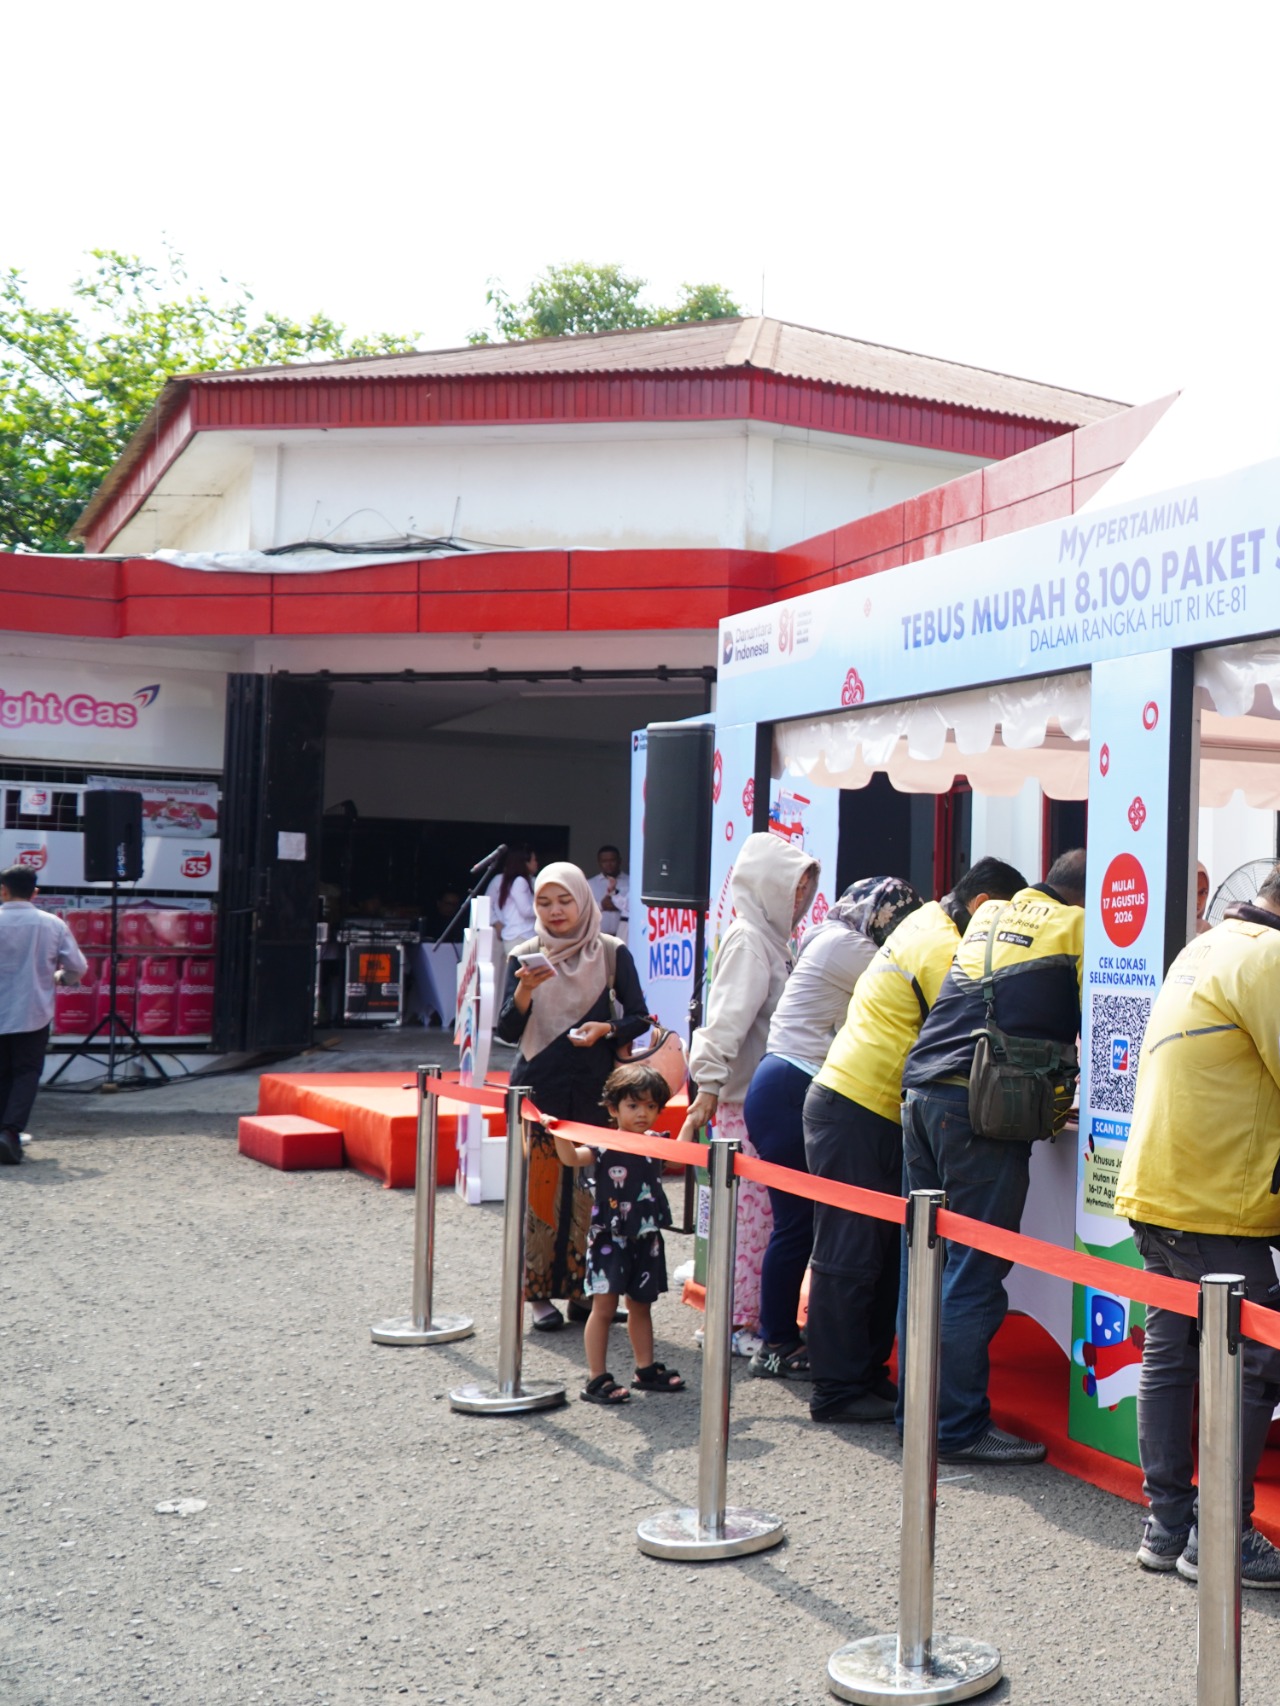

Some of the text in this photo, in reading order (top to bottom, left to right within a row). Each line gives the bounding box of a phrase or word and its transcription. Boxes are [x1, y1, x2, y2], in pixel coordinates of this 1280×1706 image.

[901, 601, 965, 650] TEBUS
[971, 577, 1067, 635] MURAH
[1075, 556, 1151, 614] 8.100
[1161, 528, 1266, 595] PAKET
[1030, 584, 1247, 652] DALAM RANGKA HUT RI KE-81
[735, 640, 769, 661] Indonesia
[0, 690, 138, 729] ght Gas
[1111, 879, 1135, 893] MULAI
[1103, 893, 1145, 909] 17 AGUSTUS
[1114, 911, 1133, 923] 2026
[1099, 957, 1147, 970] CEK LOKASI
[1090, 971, 1156, 987] SELENGKAPNYA
[1095, 1121, 1115, 1135] SCAN
[1115, 1124, 1123, 1136] DI
[1093, 1154, 1115, 1167] Khusus
[1092, 1172, 1110, 1184] Hutan
[1088, 1183, 1103, 1195] 16-17
